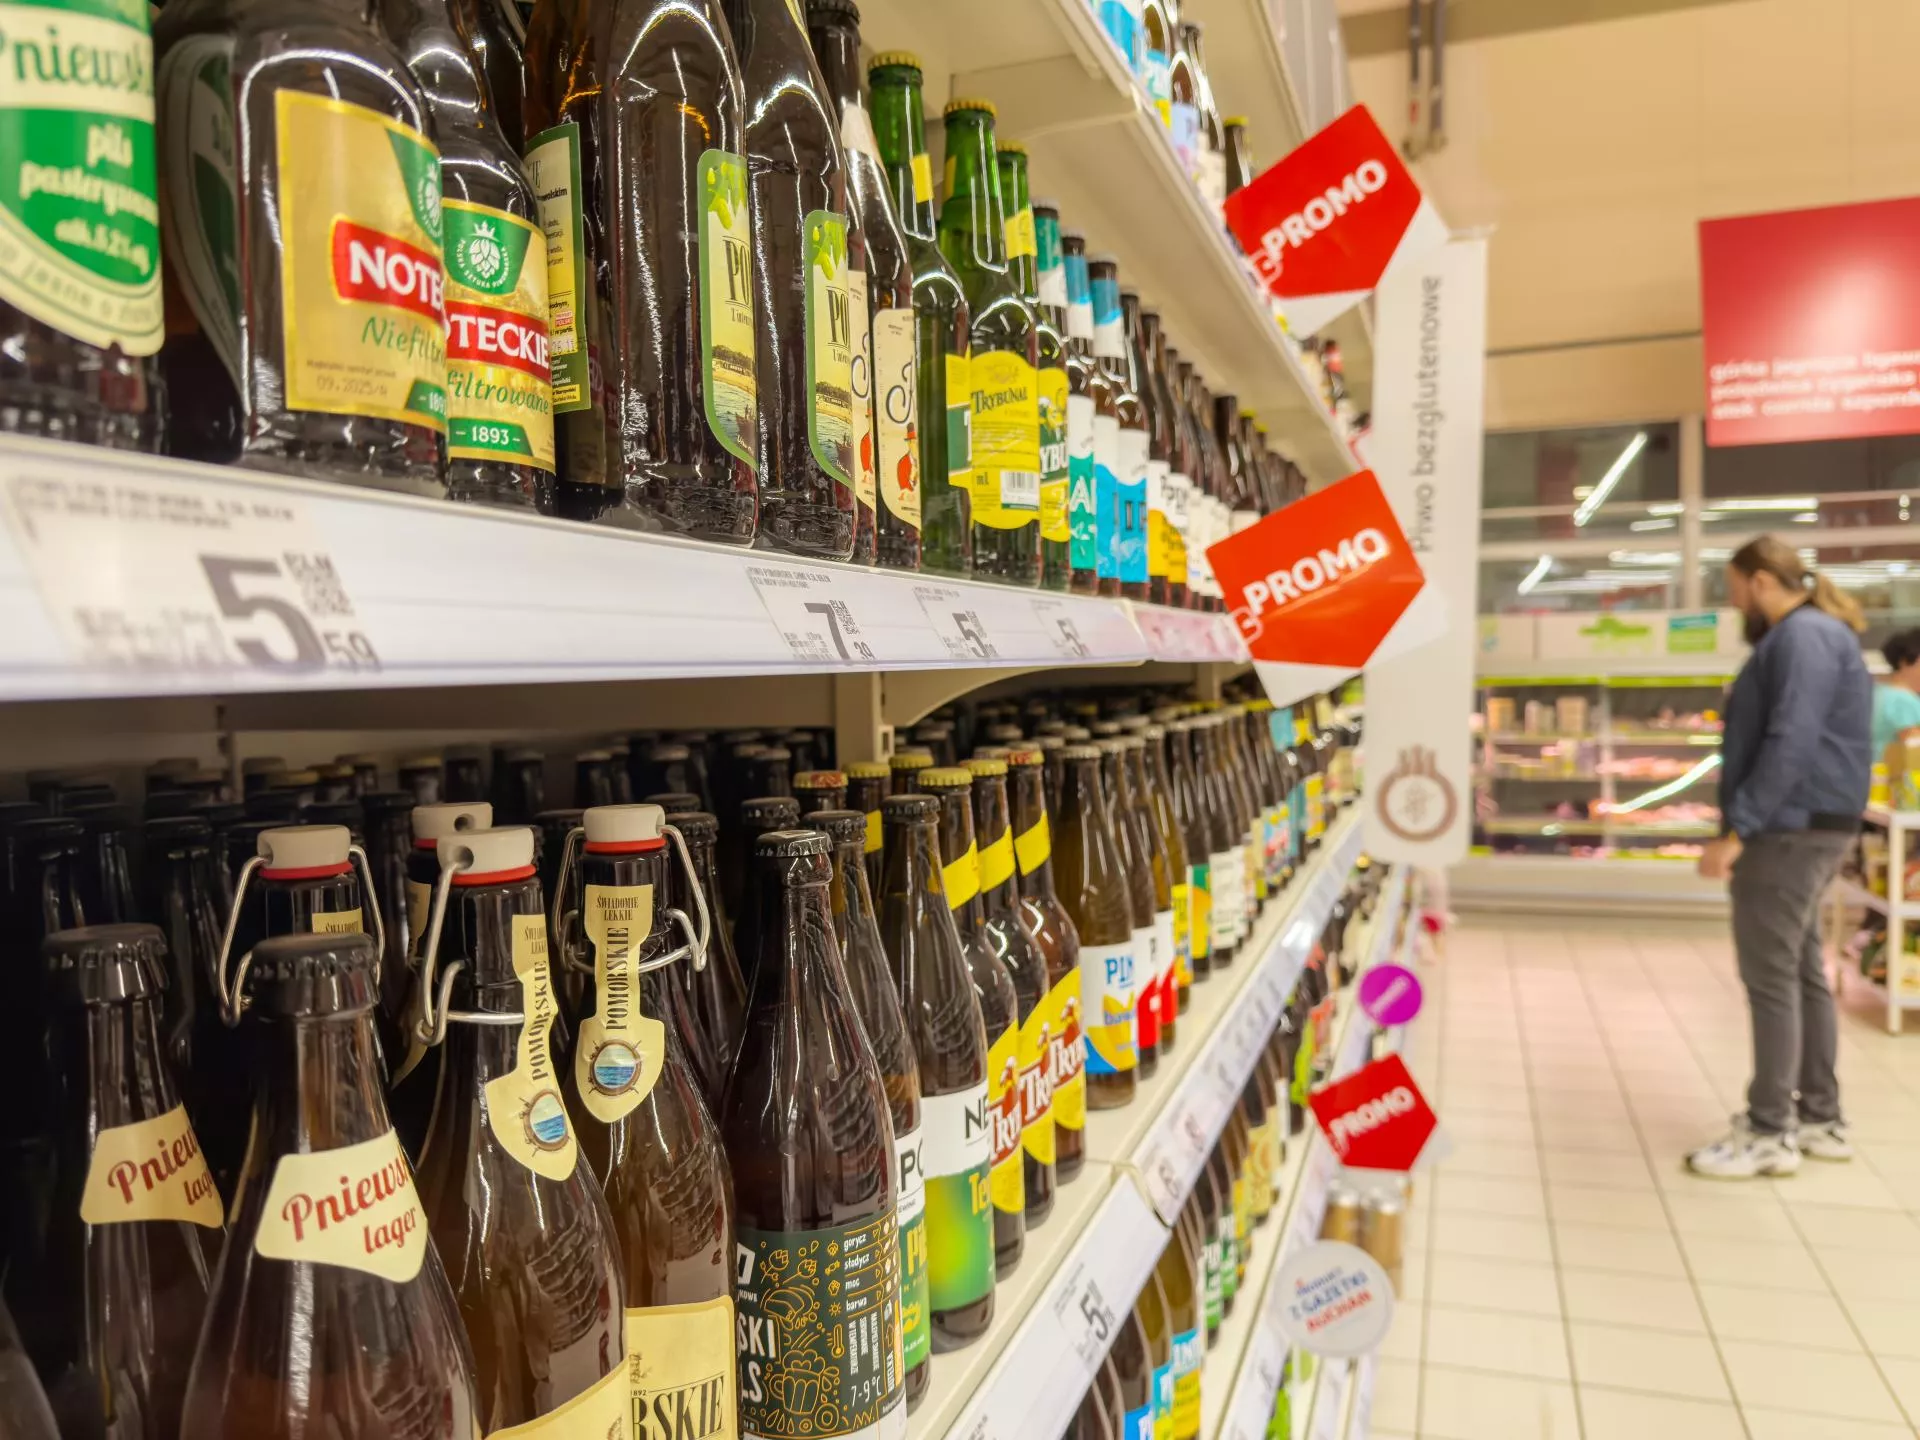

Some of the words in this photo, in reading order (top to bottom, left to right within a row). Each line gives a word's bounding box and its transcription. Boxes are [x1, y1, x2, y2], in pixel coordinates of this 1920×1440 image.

[1260, 159, 1388, 261] PROMO
[349, 240, 446, 312] NOTE
[361, 315, 446, 369] Niefiltr
[447, 314, 550, 372] TECKIE
[1410, 275, 1446, 480] bezglutenowe
[471, 424, 510, 446] 1893
[1242, 528, 1391, 616] PROMO
[197, 552, 327, 676] 5
[322, 629, 384, 675] 59
[803, 602, 852, 666] 7
[952, 612, 991, 659] 5
[596, 895, 639, 909] ŚWIADOMIE
[604, 908, 634, 922] LEKKIE
[605, 927, 630, 1031] POMORSKIE
[526, 959, 551, 1082] POMORSKIE
[363, 1206, 417, 1255] lager
[844, 1233, 867, 1253] gorycz
[845, 1278, 860, 1290] moc
[846, 1297, 868, 1311] barwa
[1079, 1293, 1109, 1341] 5
